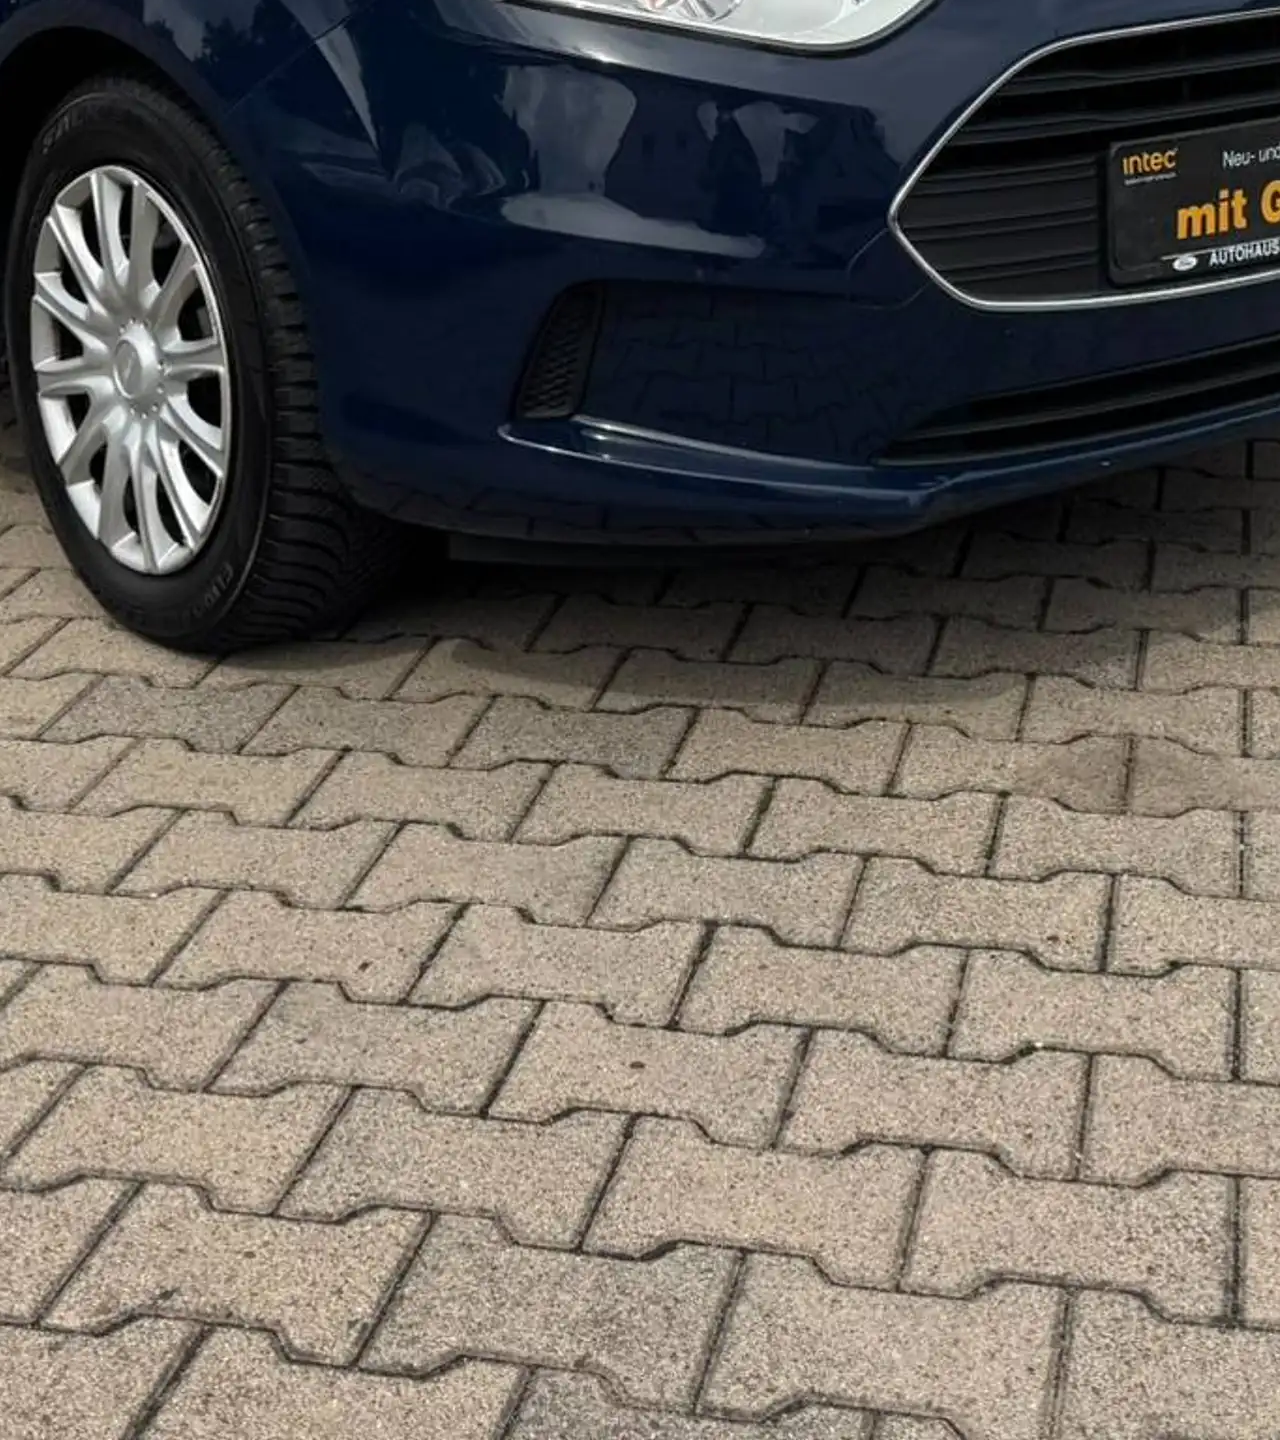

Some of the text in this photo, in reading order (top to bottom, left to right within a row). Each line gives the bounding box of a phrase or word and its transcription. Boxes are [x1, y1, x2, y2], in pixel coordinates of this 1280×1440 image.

[1222, 149, 1255, 168] Neu-
[1176, 187, 1248, 240] mit
[1209, 238, 1280, 267] AUTOHAUS
